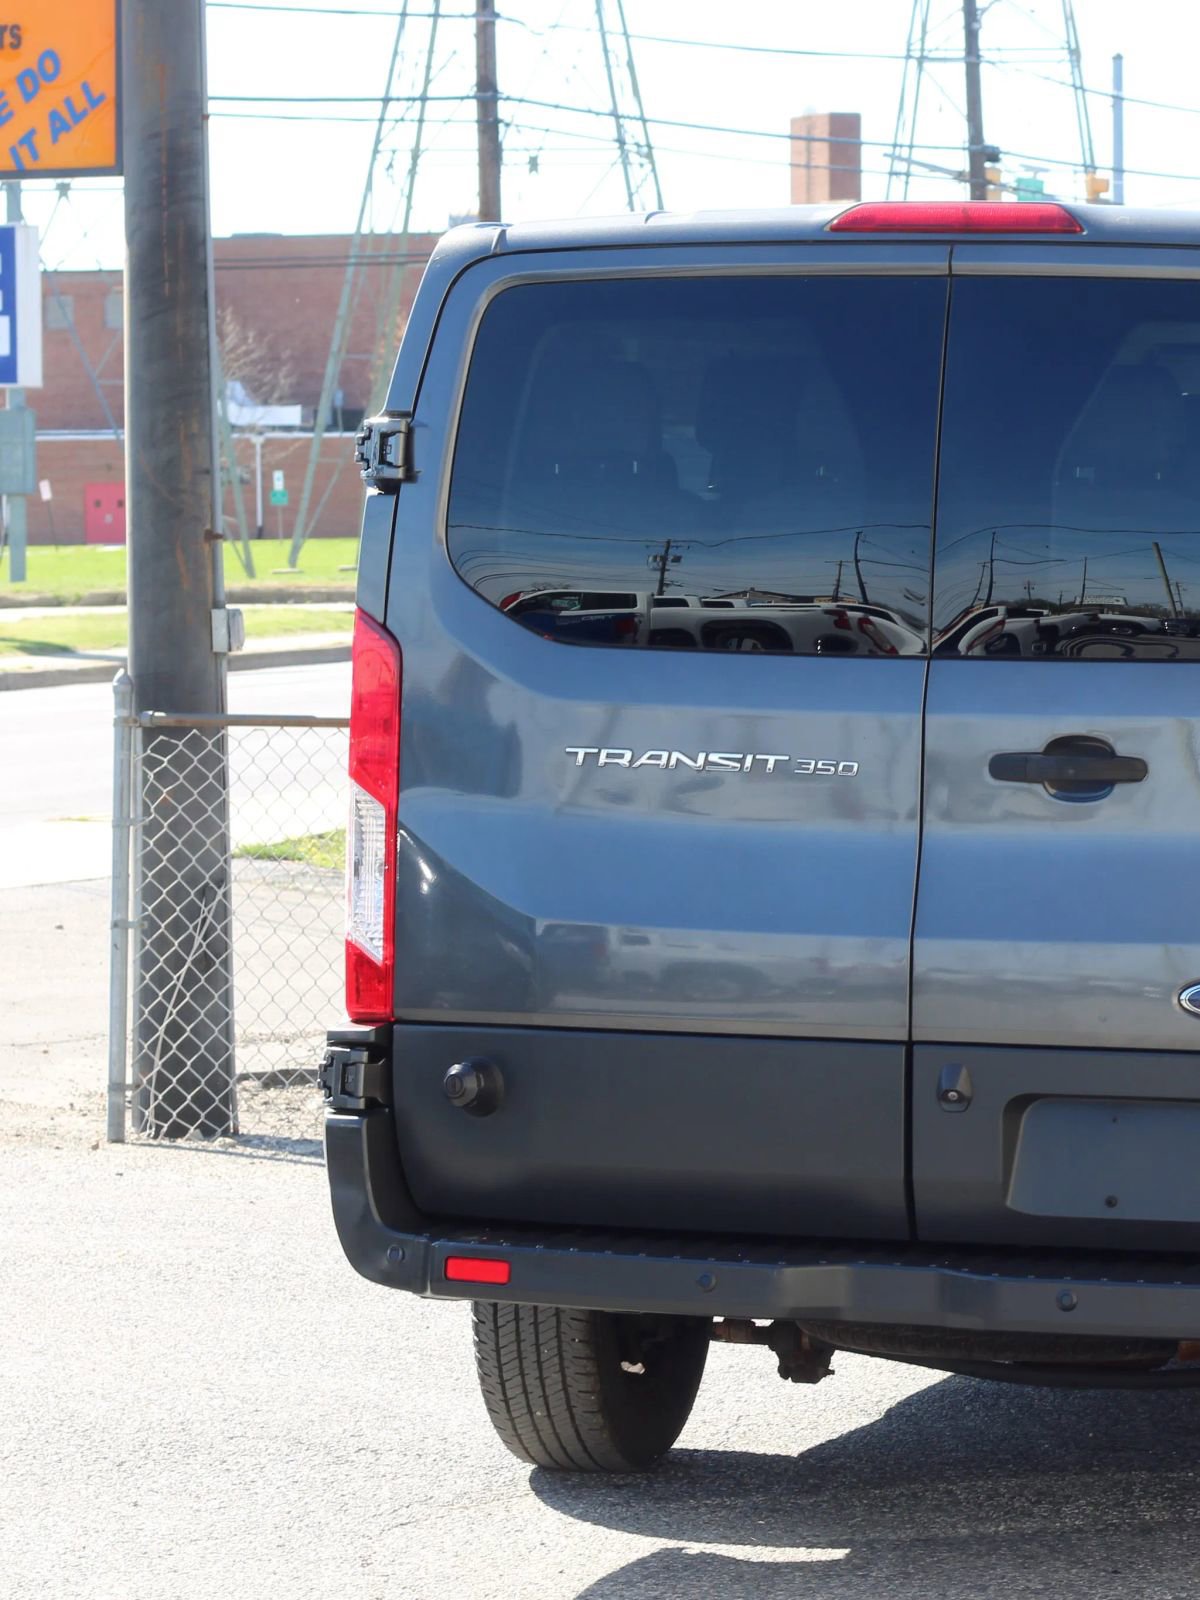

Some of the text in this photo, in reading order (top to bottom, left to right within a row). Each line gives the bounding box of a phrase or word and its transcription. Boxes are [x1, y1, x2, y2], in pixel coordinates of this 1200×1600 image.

[16, 48, 61, 103] DO
[9, 81, 106, 171] IT ALL
[565, 746, 859, 777] TRANSIT 350
